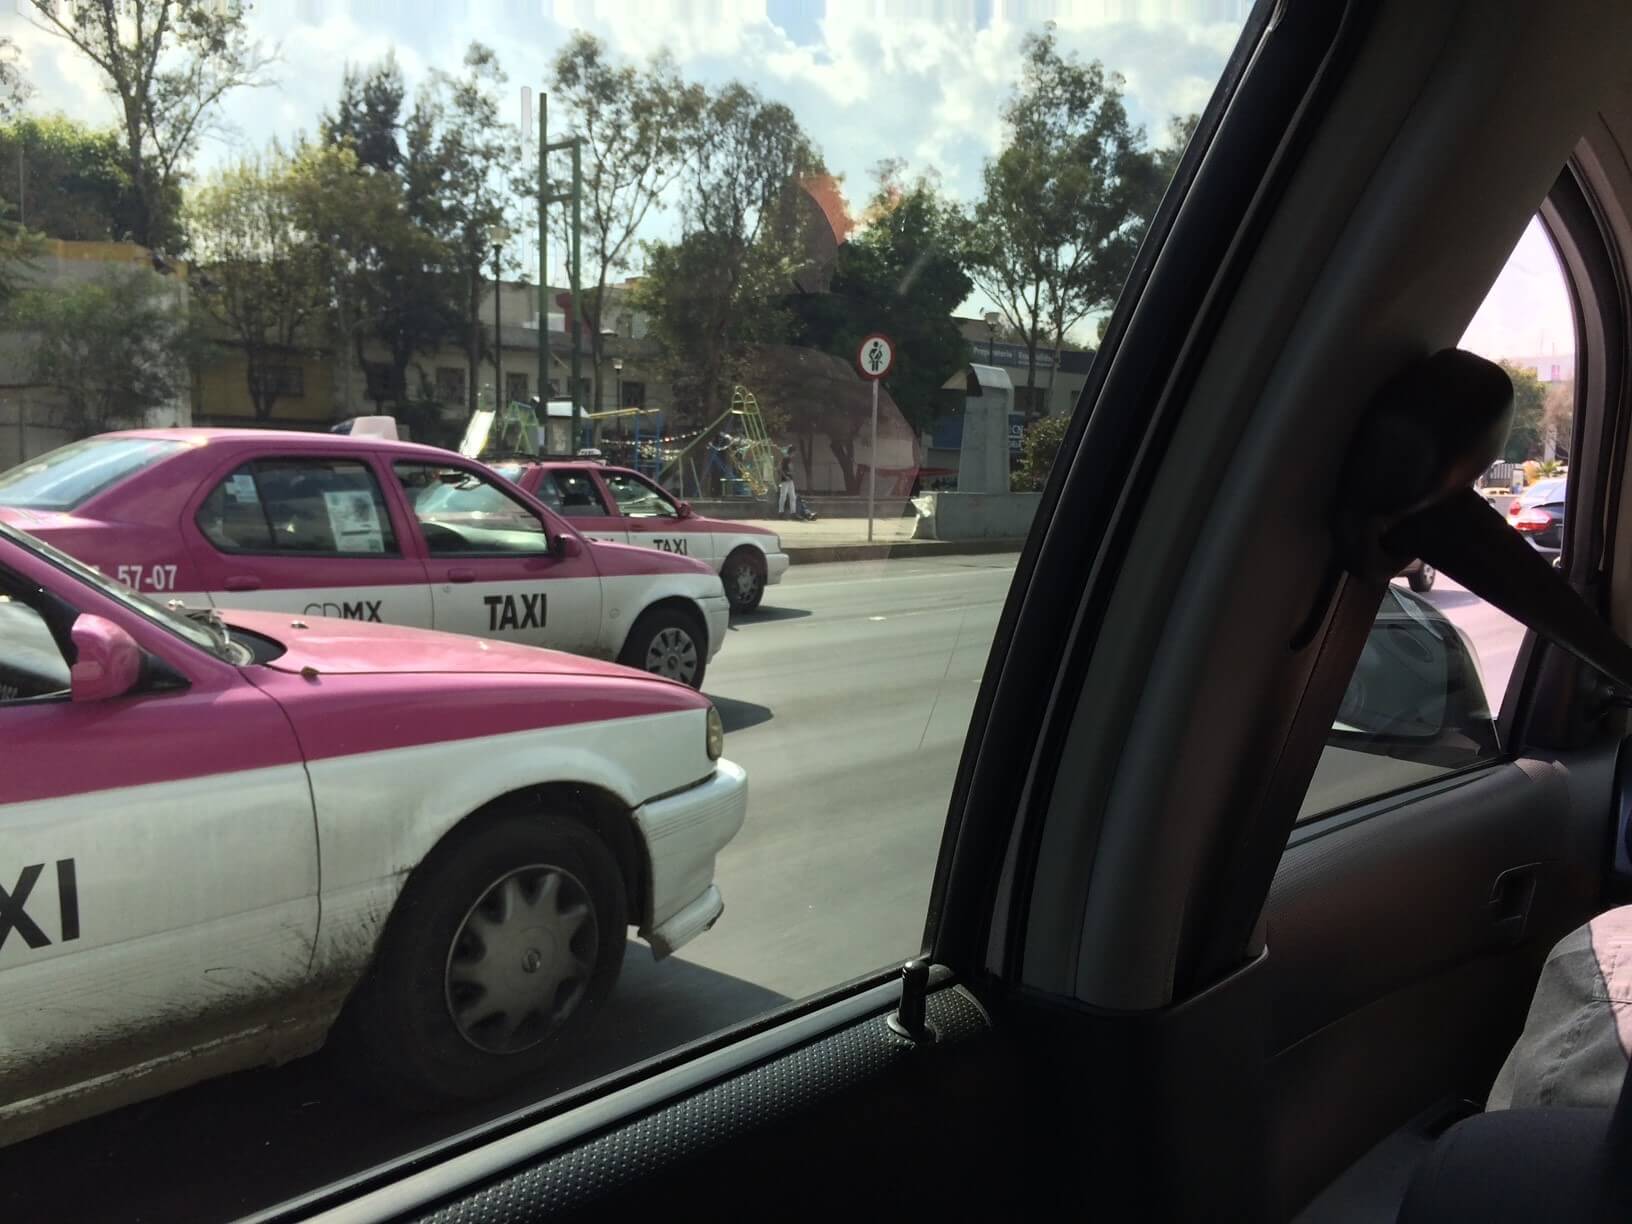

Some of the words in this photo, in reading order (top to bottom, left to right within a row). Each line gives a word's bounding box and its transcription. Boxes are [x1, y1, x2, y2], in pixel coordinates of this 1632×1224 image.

[653, 538, 688, 556] TAXI
[118, 565, 177, 591] 57-07
[484, 593, 547, 631] TAXI
